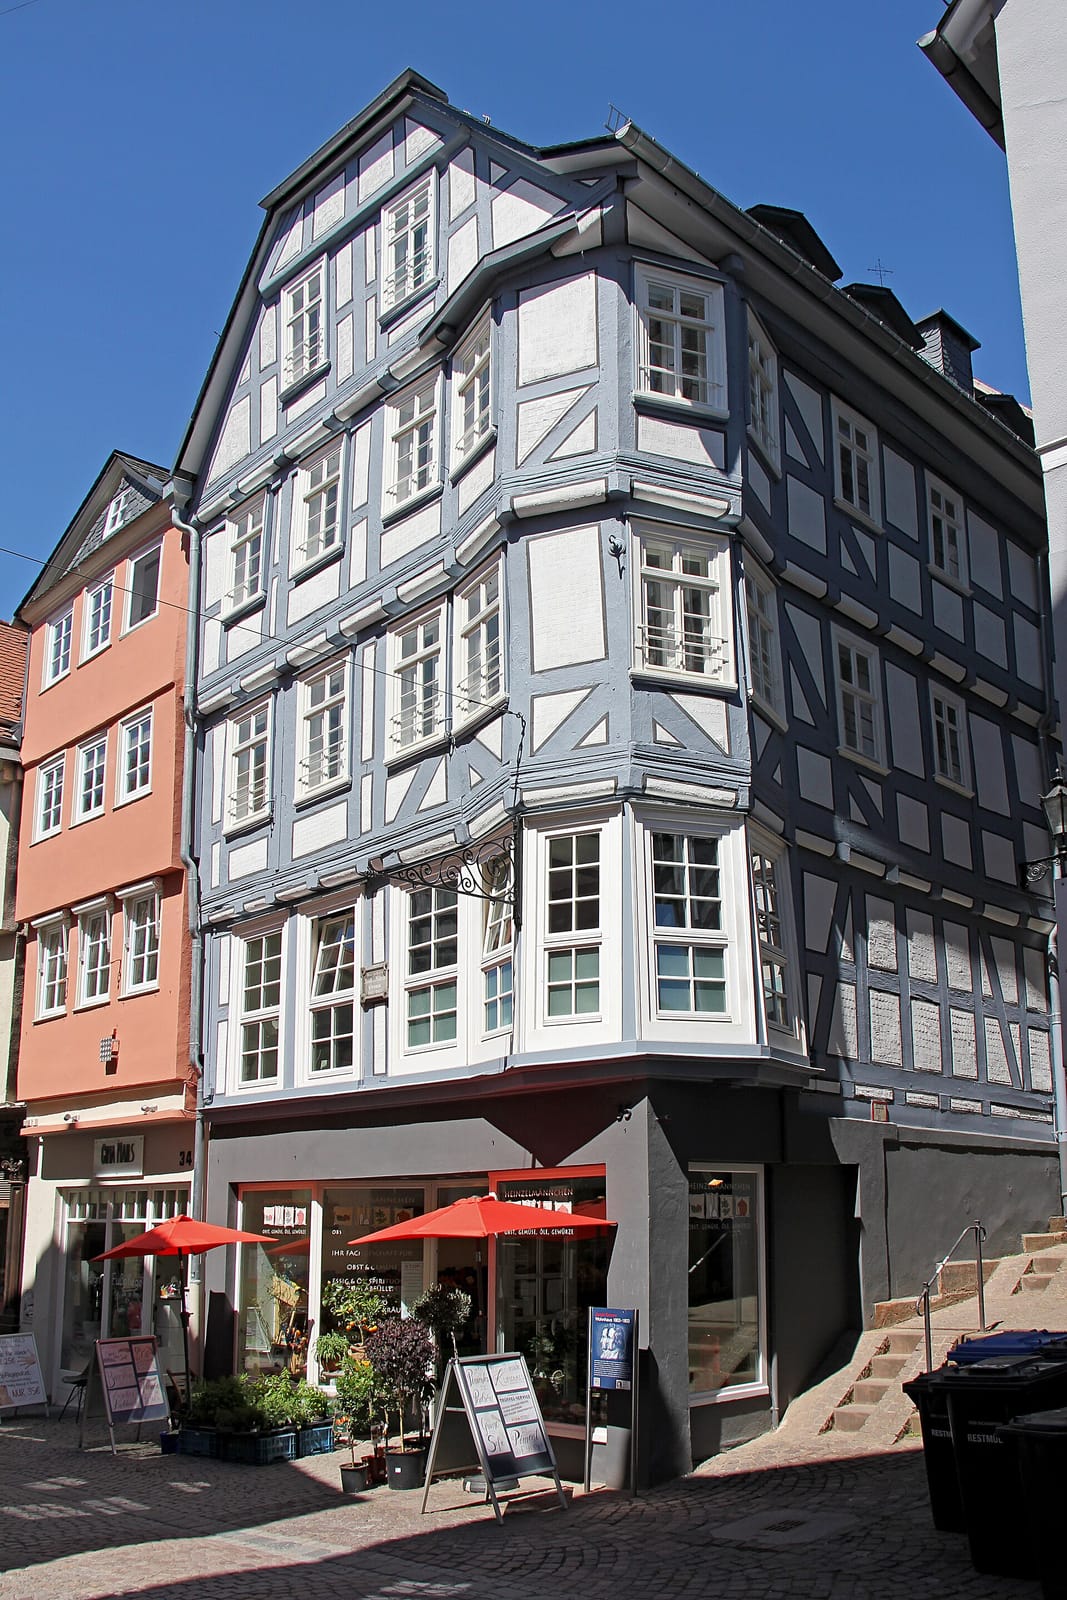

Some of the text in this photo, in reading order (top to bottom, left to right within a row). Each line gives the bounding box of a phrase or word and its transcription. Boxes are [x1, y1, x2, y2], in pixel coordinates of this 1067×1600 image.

[179, 1151, 192, 1166] 34
[346, 1263, 363, 1271] OBST
[364, 1263, 369, 1271] &
[931, 1429, 952, 1438] RESTM
